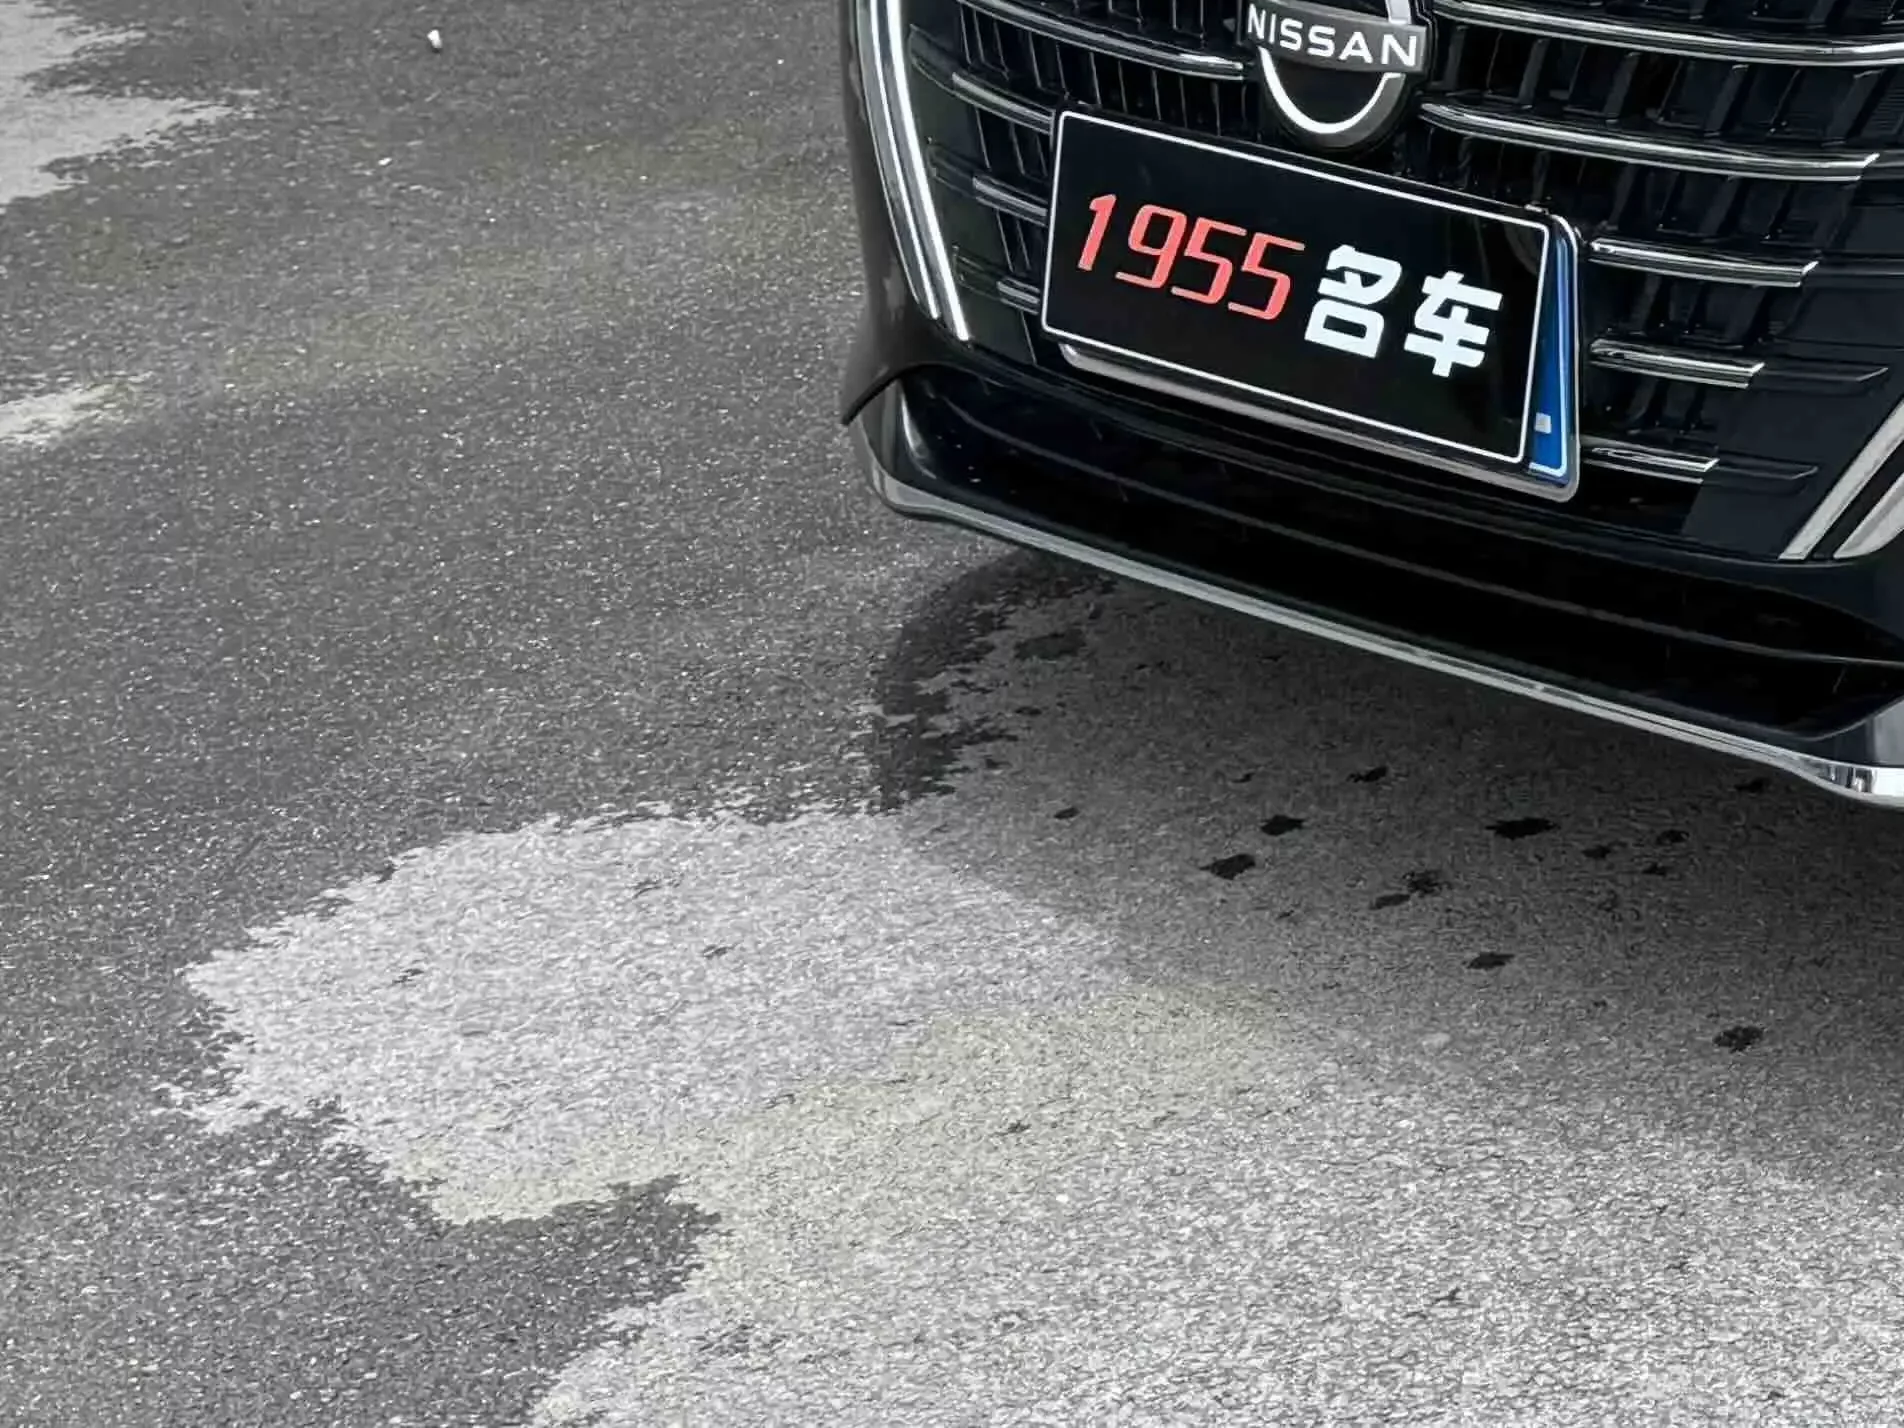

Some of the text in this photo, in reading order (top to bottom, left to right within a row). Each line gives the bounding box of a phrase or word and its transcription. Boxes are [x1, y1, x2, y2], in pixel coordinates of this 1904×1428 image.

[1247, 2, 1419, 68] NISSAN
[1078, 194, 1504, 378] 1955 名车
